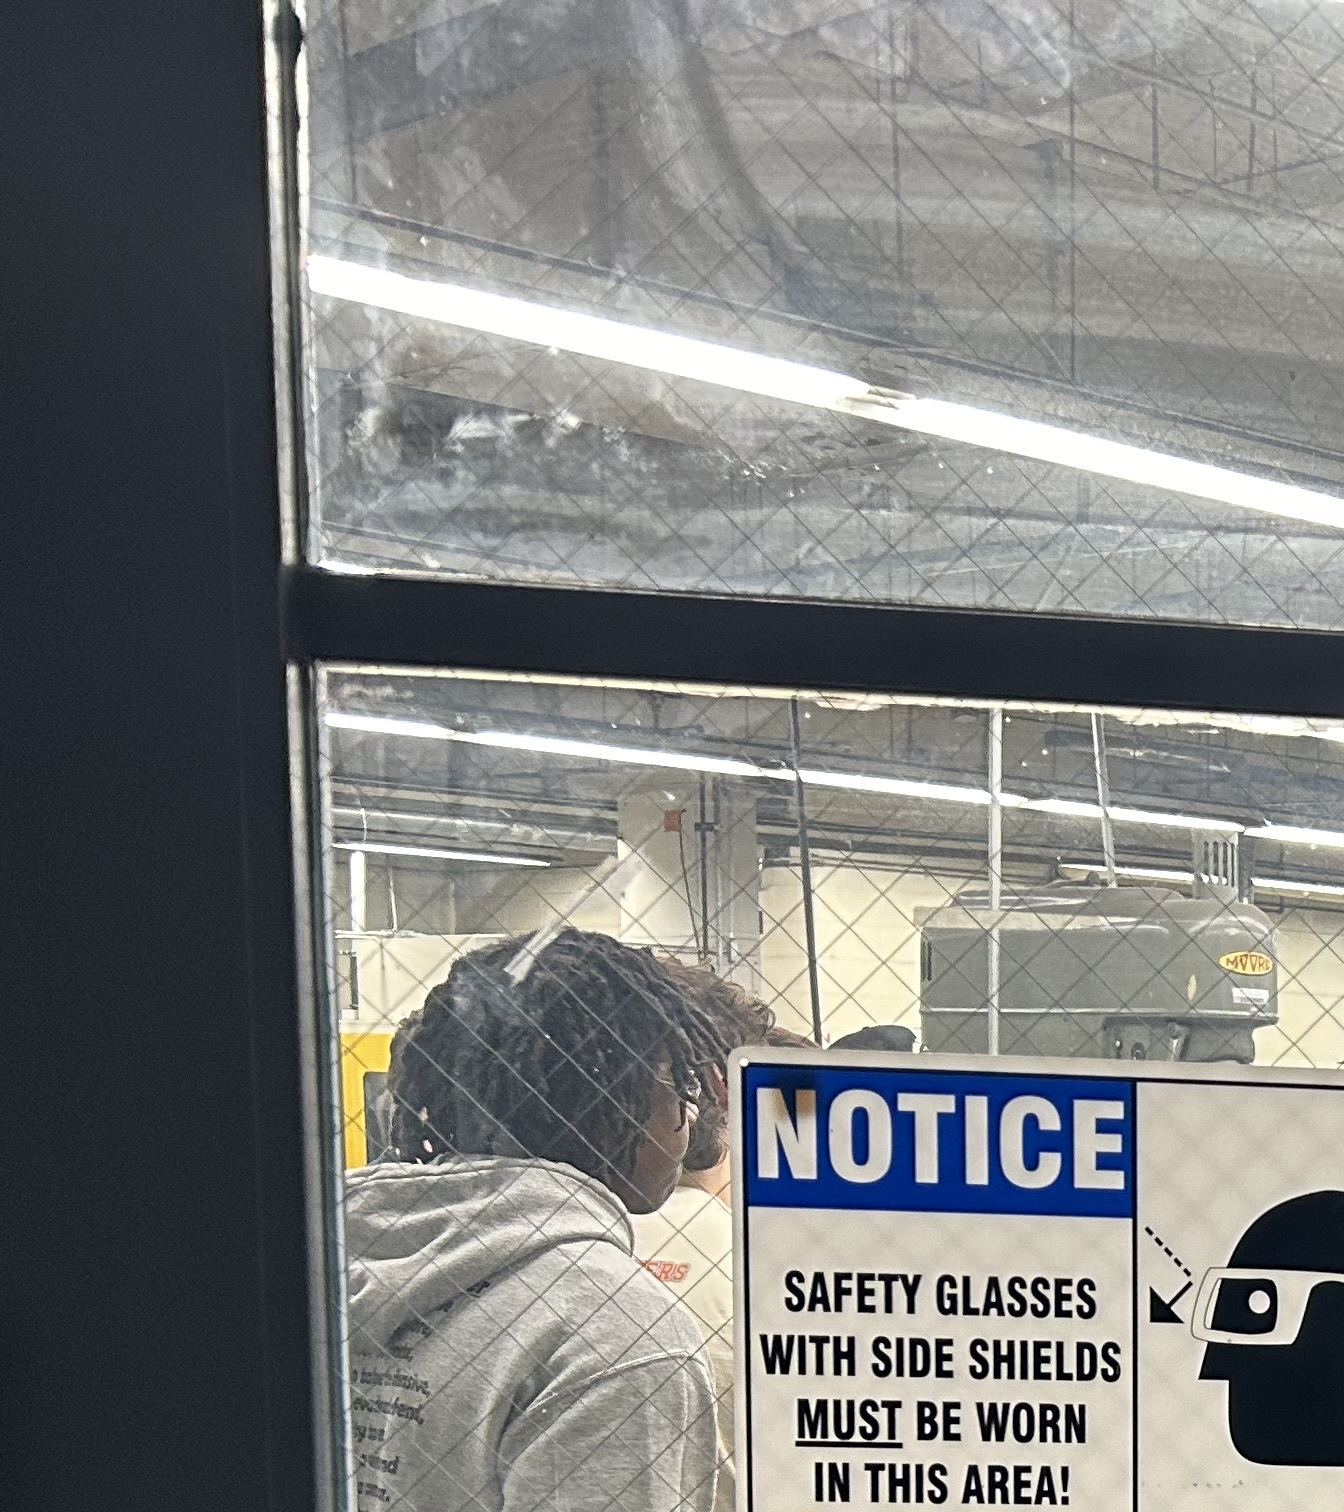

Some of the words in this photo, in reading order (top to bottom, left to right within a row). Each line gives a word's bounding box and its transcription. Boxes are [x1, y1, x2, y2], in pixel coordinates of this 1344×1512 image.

[1225, 953, 1271, 972] MOORE
[756, 1087, 1125, 1190] NOTICE
[784, 1270, 922, 1315] SAFETY
[936, 1274, 1097, 1320] GLASSES
[760, 1333, 856, 1377] WITH
[871, 1335, 954, 1379] SIDE
[969, 1338, 1121, 1383] SHIELDS
[796, 1398, 903, 1444] MUST
[916, 1400, 962, 1442] BE
[975, 1401, 1086, 1444] WORN
[814, 1462, 850, 1503] IN
[864, 1462, 948, 1505] THIS
[961, 1464, 1070, 1506] AREA!
